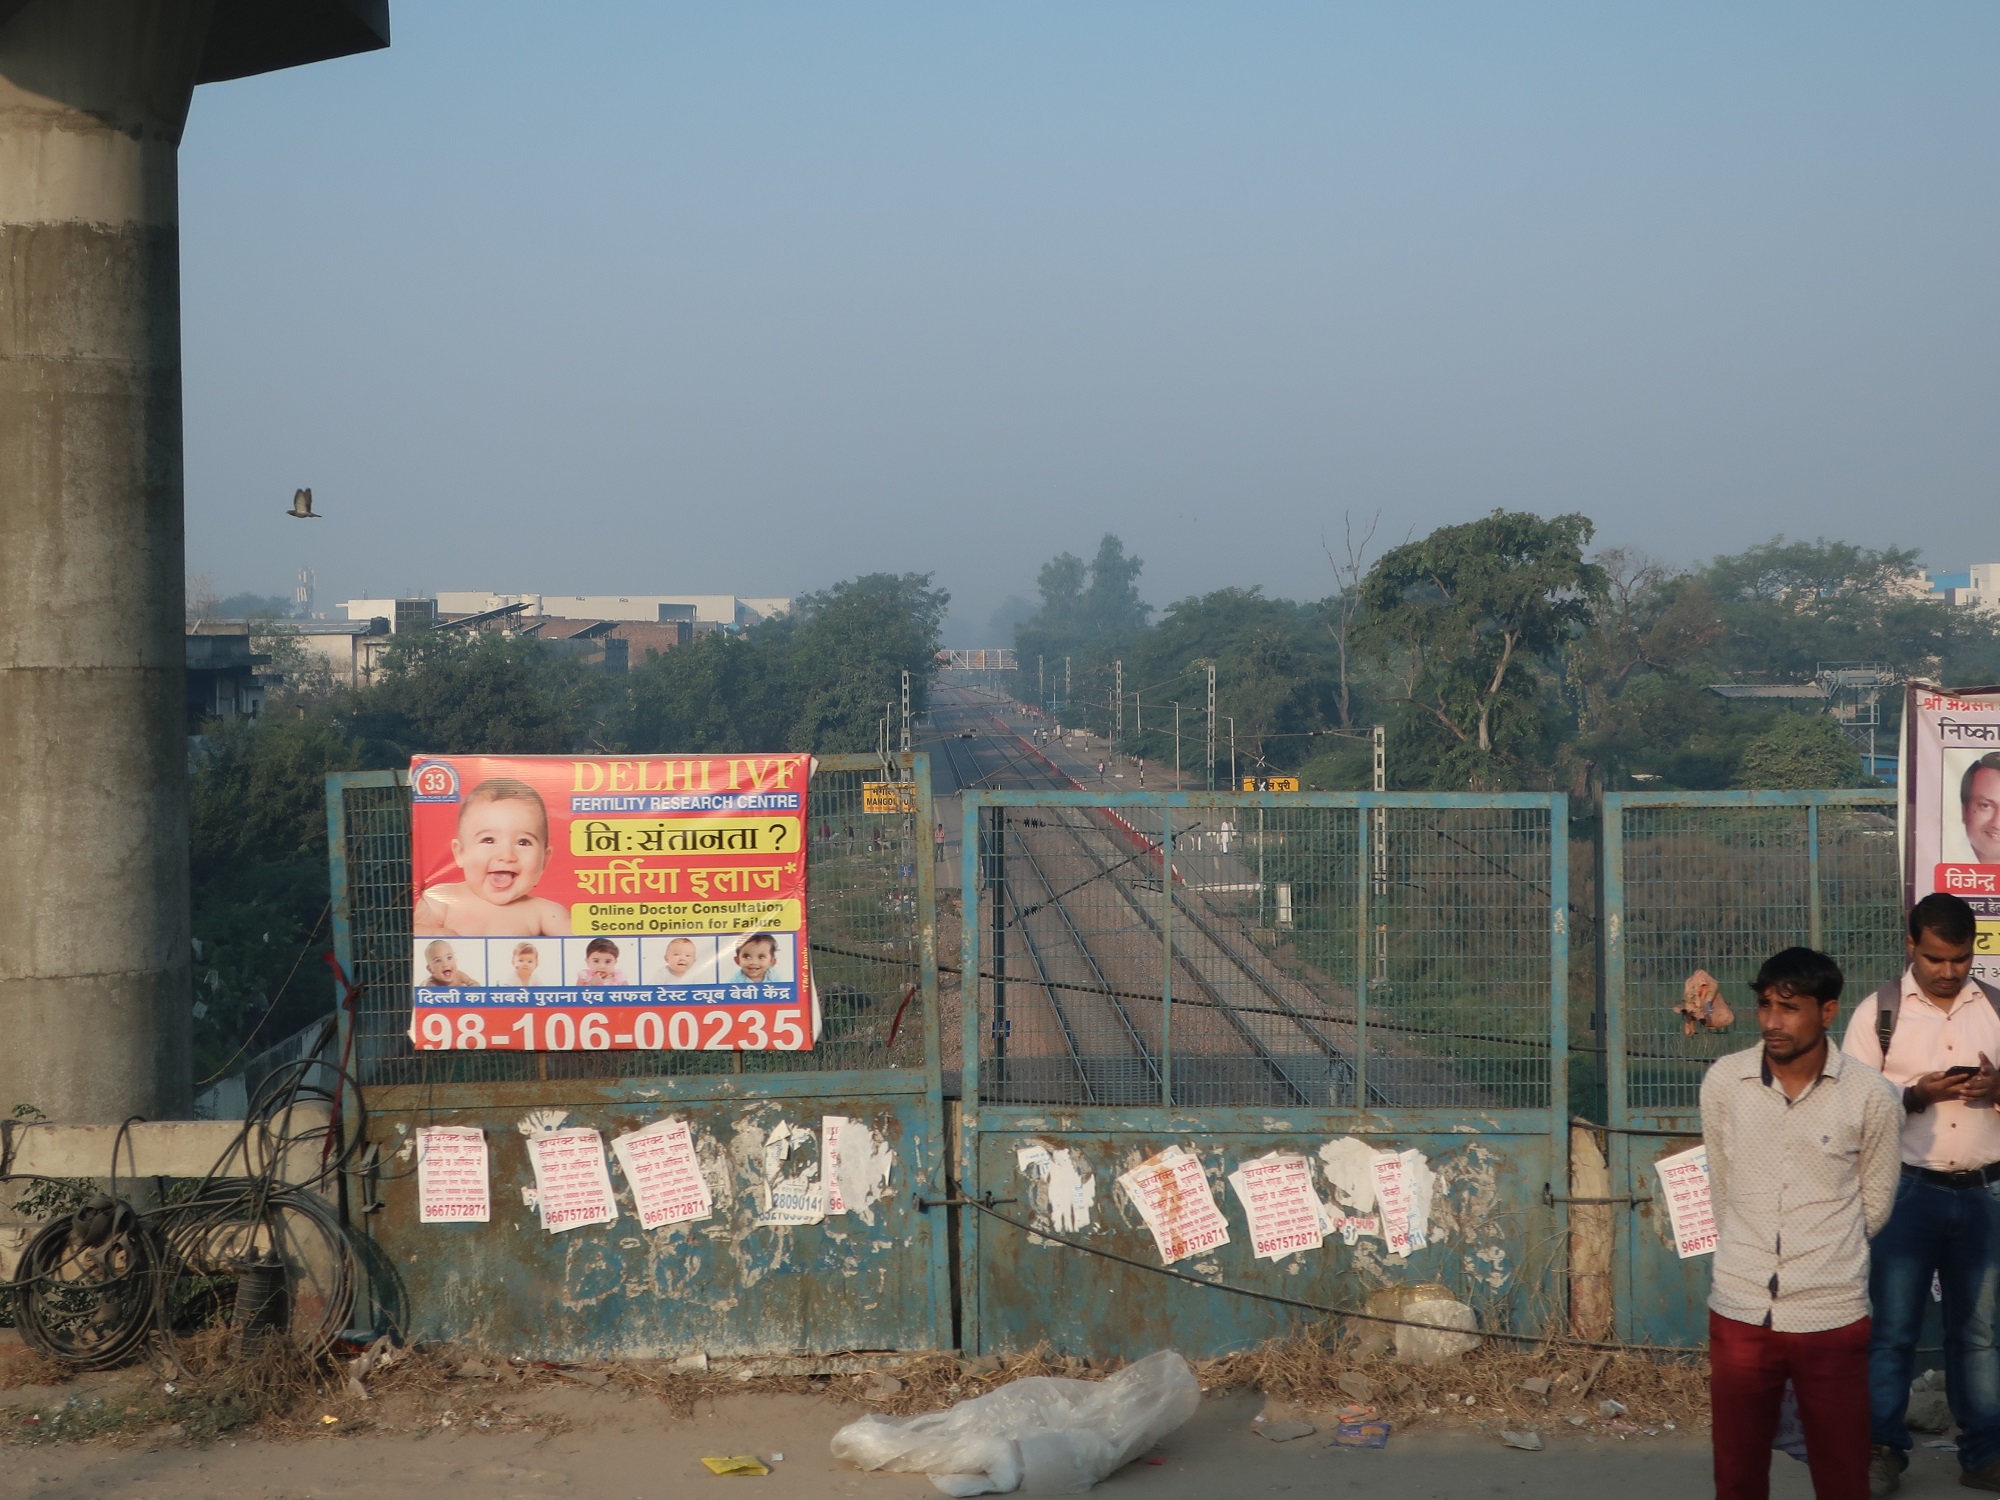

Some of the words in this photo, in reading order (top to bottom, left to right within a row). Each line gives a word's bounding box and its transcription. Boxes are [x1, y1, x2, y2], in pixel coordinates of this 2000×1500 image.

[1923, 694, 1943, 711] श्री
[425, 774, 445, 791] 33
[571, 760, 713, 792] DELHI
[726, 759, 801, 790] IVF
[572, 797, 646, 811] FERTILITY
[652, 795, 734, 811] RESEARCH
[737, 795, 798, 809] CENTRE
[574, 858, 680, 895] शर्तिया
[1945, 868, 1996, 892] विजेन्द्र
[589, 905, 634, 916] Online
[640, 903, 688, 915] Doctor
[692, 902, 784, 914] Consultation
[591, 920, 644, 931] Second
[650, 920, 706, 932] Opinion
[708, 919, 729, 930] for
[732, 918, 782, 929] Failure
[418, 989, 461, 1004] दिल्ली
[465, 992, 486, 1003] का
[490, 989, 530, 1003] सबसे
[534, 992, 578, 1007] पुराना
[608, 991, 657, 1003] सफल
[657, 987, 689, 1002] टेस्ट
[692, 989, 726, 1004] ट्यूब
[729, 985, 759, 1000] बेबी
[422, 1010, 804, 1050] 98-106-00235
[425, 1205, 486, 1217] 9667572871
[546, 1206, 607, 1224] 9667572871
[644, 1200, 705, 1224] 9667572871
[1165, 1228, 1225, 1259] 9667572871
[1257, 1231, 1319, 1253] 9667572871
